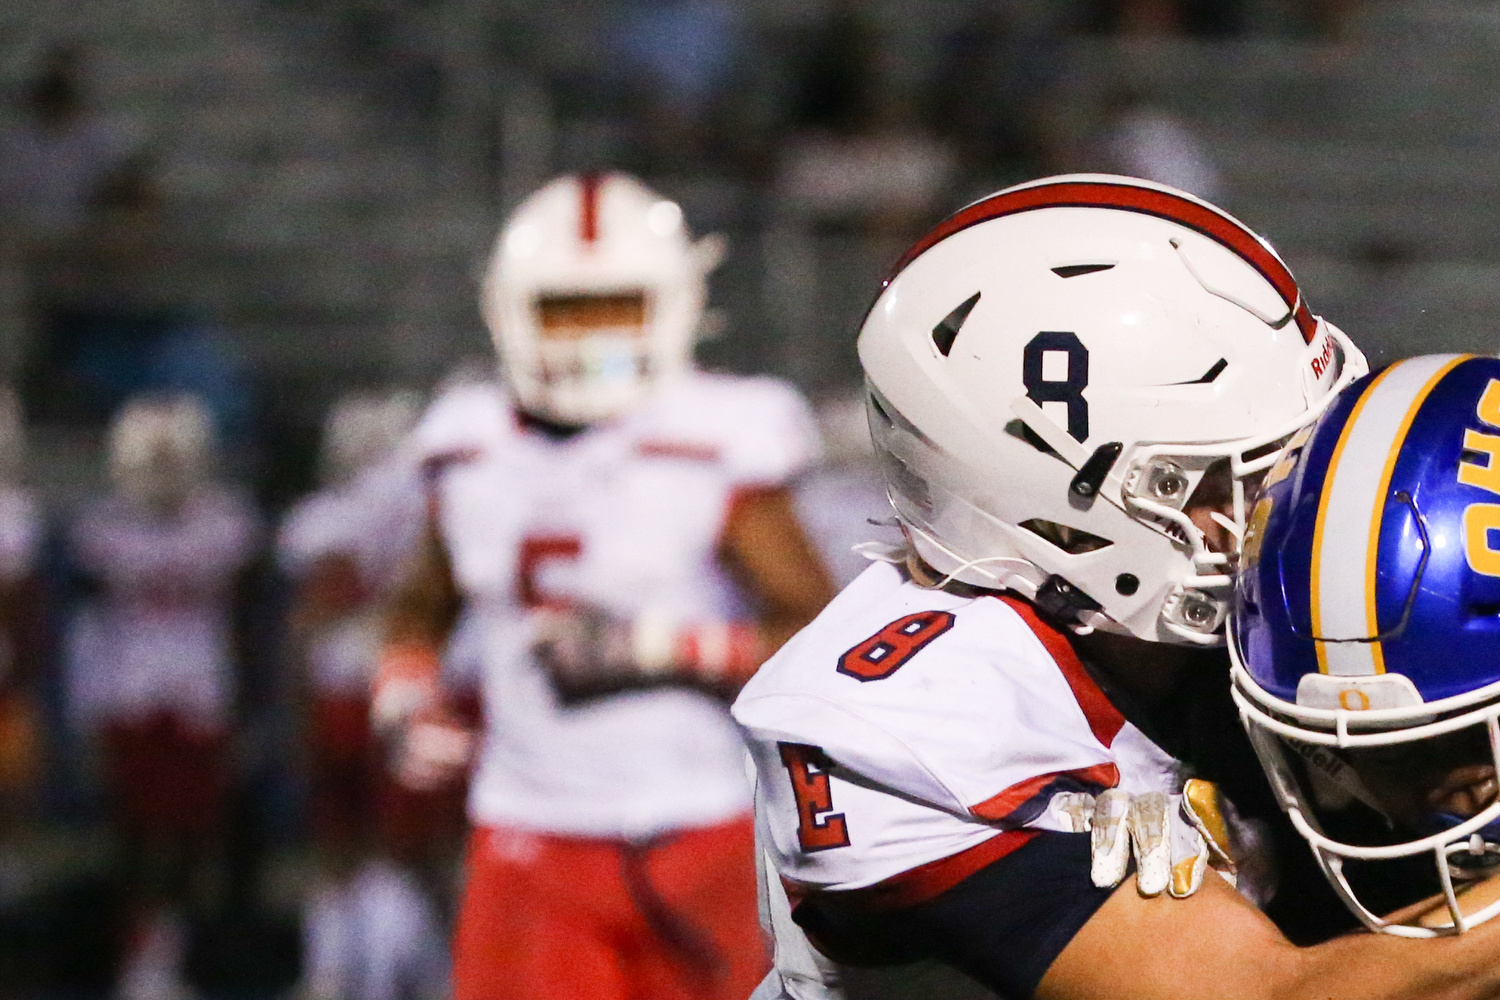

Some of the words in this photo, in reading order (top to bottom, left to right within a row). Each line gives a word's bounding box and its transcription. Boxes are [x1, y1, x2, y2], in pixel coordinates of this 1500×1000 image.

[1023, 331, 1089, 444] 8
[836, 609, 956, 683] 8
[777, 741, 852, 854] E
